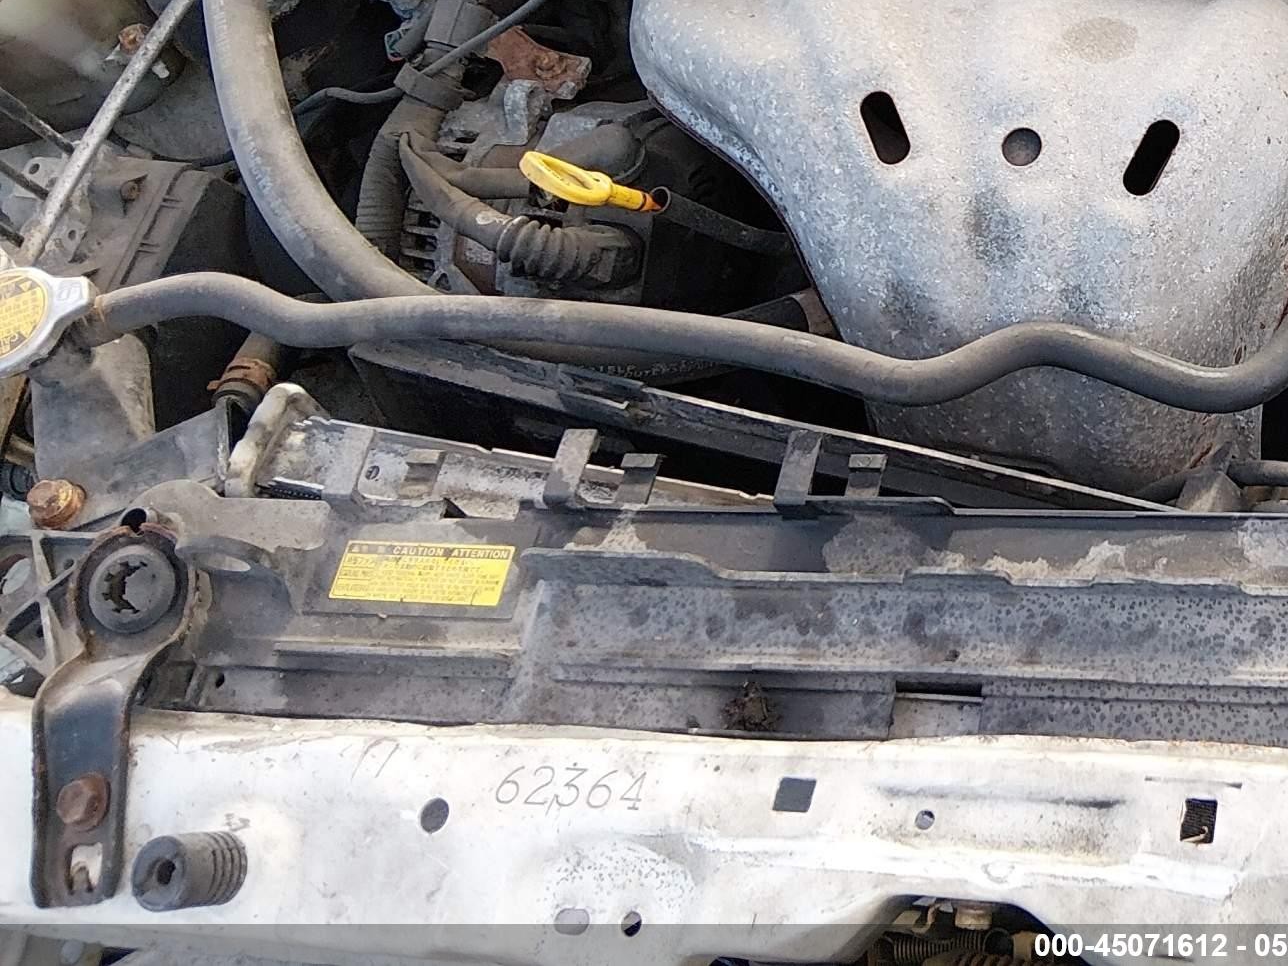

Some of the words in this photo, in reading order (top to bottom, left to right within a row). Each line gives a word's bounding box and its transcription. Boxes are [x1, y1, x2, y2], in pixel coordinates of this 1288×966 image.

[393, 546, 444, 557] CAUTION
[450, 547, 509, 559] ATTENTION
[495, 765, 647, 811] 62364
